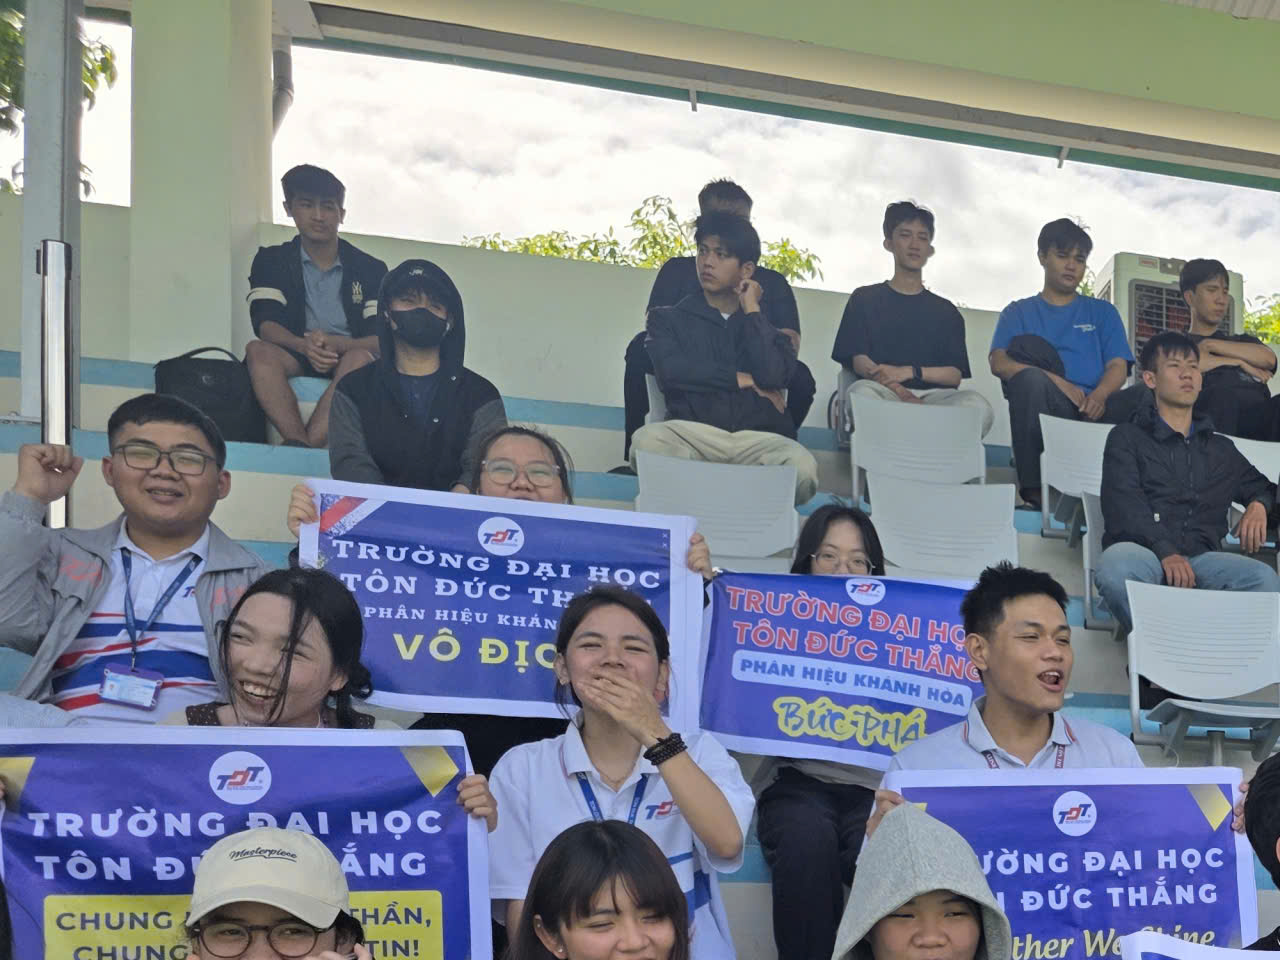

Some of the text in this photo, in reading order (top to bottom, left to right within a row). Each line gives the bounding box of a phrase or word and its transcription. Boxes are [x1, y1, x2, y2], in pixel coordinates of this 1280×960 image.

[331, 538, 661, 591] TRƯỜNG ĐẠI HỌC
[340, 569, 417, 595] TÔN
[434, 575, 512, 601] ĐỨC
[363, 603, 557, 631] PHÂN HIỆU KHÁN
[726, 586, 966, 652] TRƯỜNG ĐẠI HỌ
[392, 628, 558, 674] VÔ ĐỊC
[733, 619, 983, 683] TÔN ĐỨC THẮNG
[740, 656, 966, 707] PHÂN HIỆU KHÁNH HÒA
[28, 806, 225, 837] TRƯỜNG
[351, 809, 442, 841] HỌC
[35, 849, 132, 882] TÔN
[340, 842, 427, 876] ẮNG
[229, 846, 298, 860] Masterpiece
[977, 846, 1224, 878] ƯỜNG ĐẠI HỌC
[1021, 884, 1092, 912] ĐỨC
[1106, 874, 1218, 908] THẮNG
[56, 911, 173, 932] CHUNG
